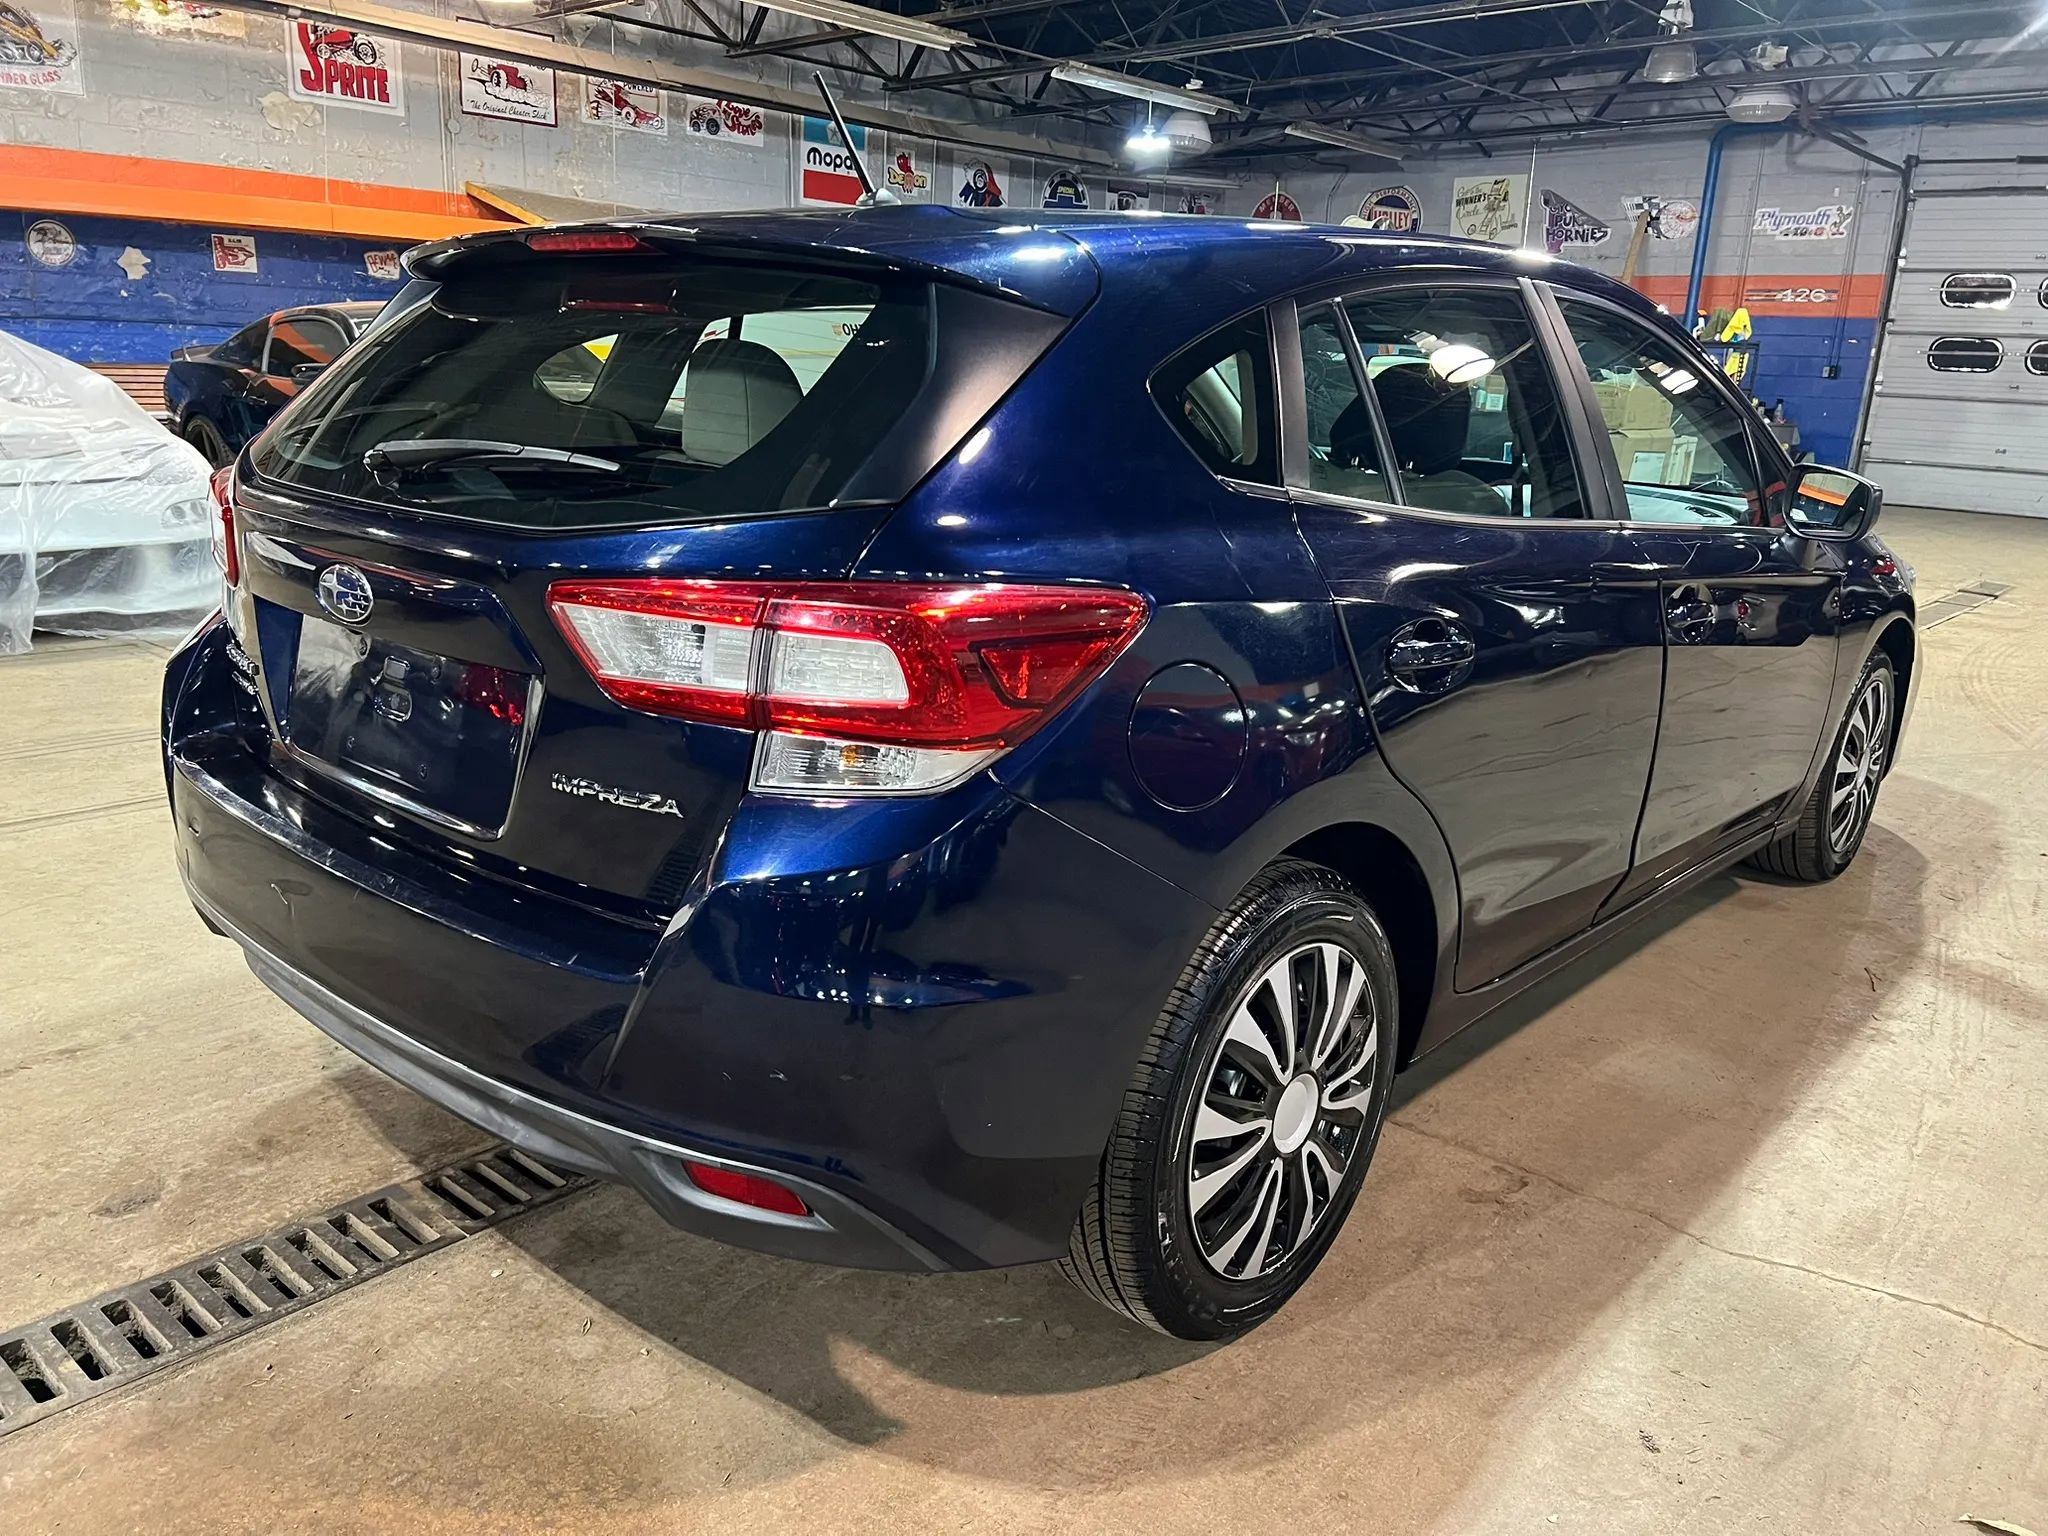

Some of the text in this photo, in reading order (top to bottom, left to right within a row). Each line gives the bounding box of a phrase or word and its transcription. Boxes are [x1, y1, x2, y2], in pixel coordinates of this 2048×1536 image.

[298, 22, 390, 103] SPRITE
[483, 102, 507, 115] Original
[1757, 209, 1832, 231] Plymouth
[1781, 288, 1827, 303] 426
[551, 772, 684, 819] IMPREZA
